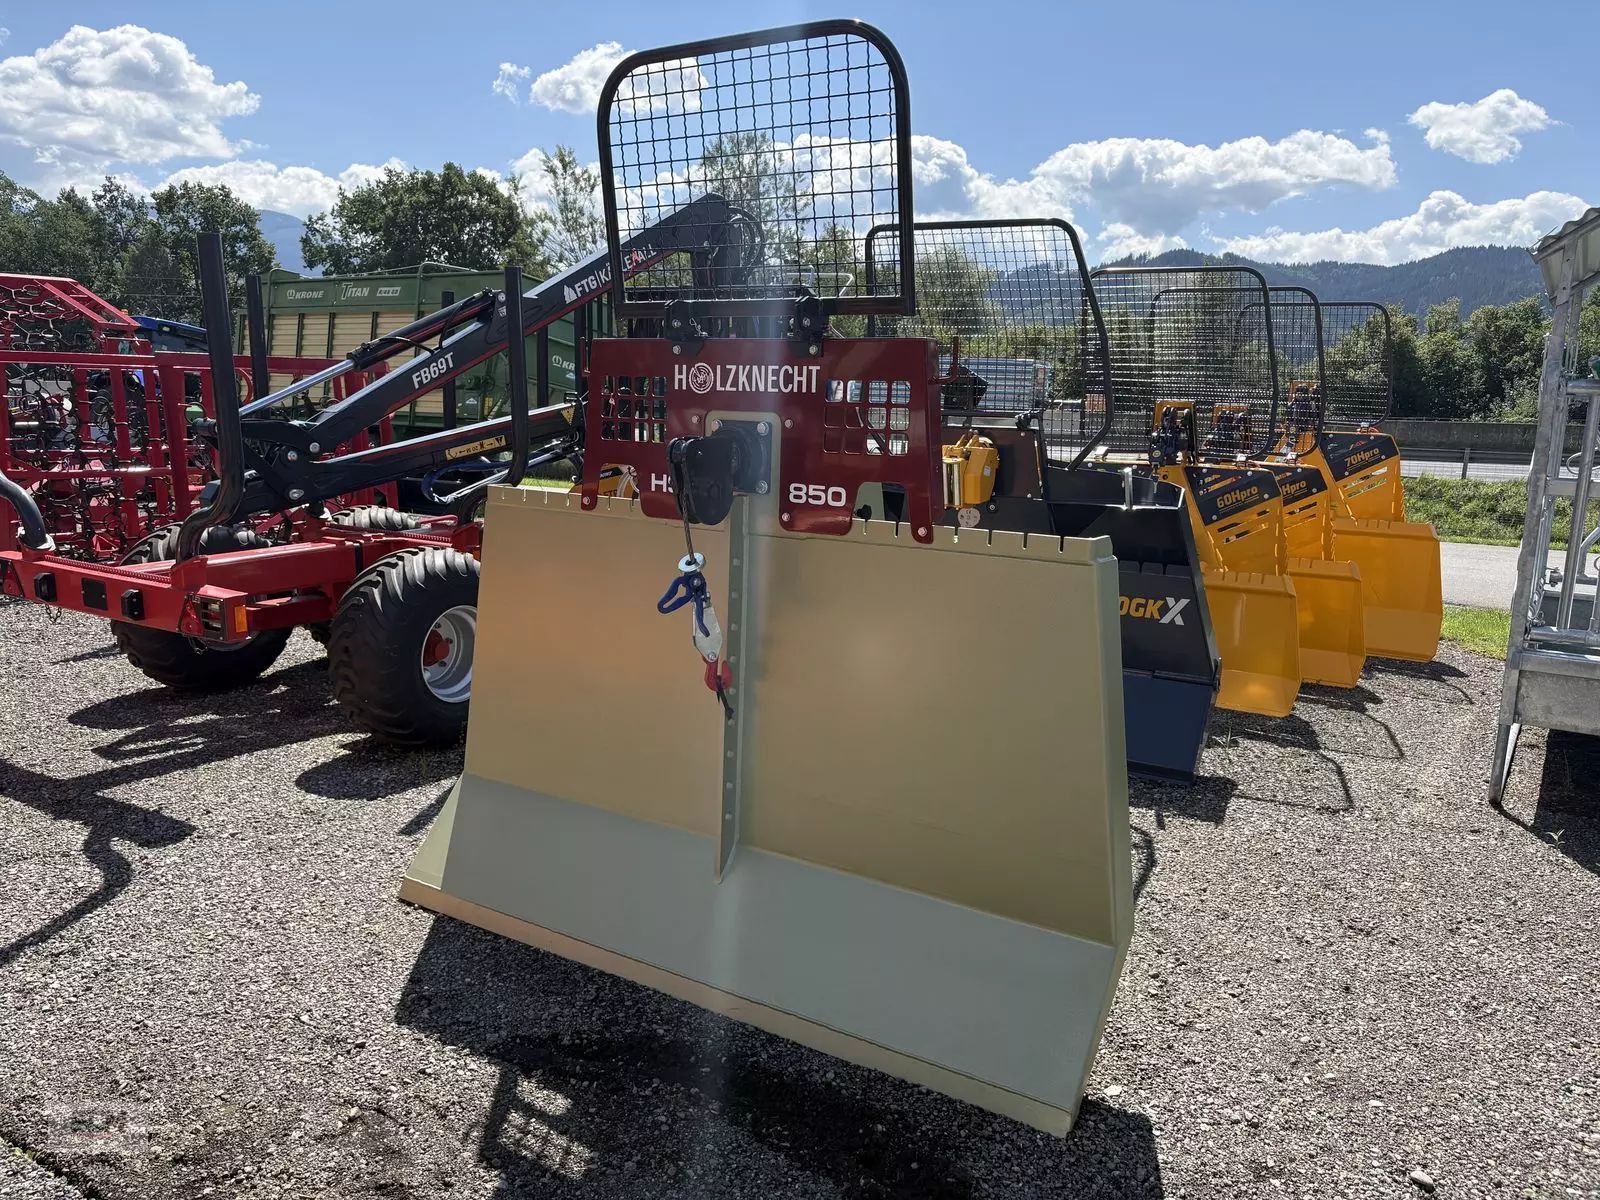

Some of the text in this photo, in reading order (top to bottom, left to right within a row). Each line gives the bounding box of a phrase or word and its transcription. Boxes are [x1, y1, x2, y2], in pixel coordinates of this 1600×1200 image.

[295, 290, 324, 299] KRONE
[412, 352, 454, 389] FB69T
[674, 362, 821, 394] HOLZKNECHT
[789, 483, 847, 507] 850
